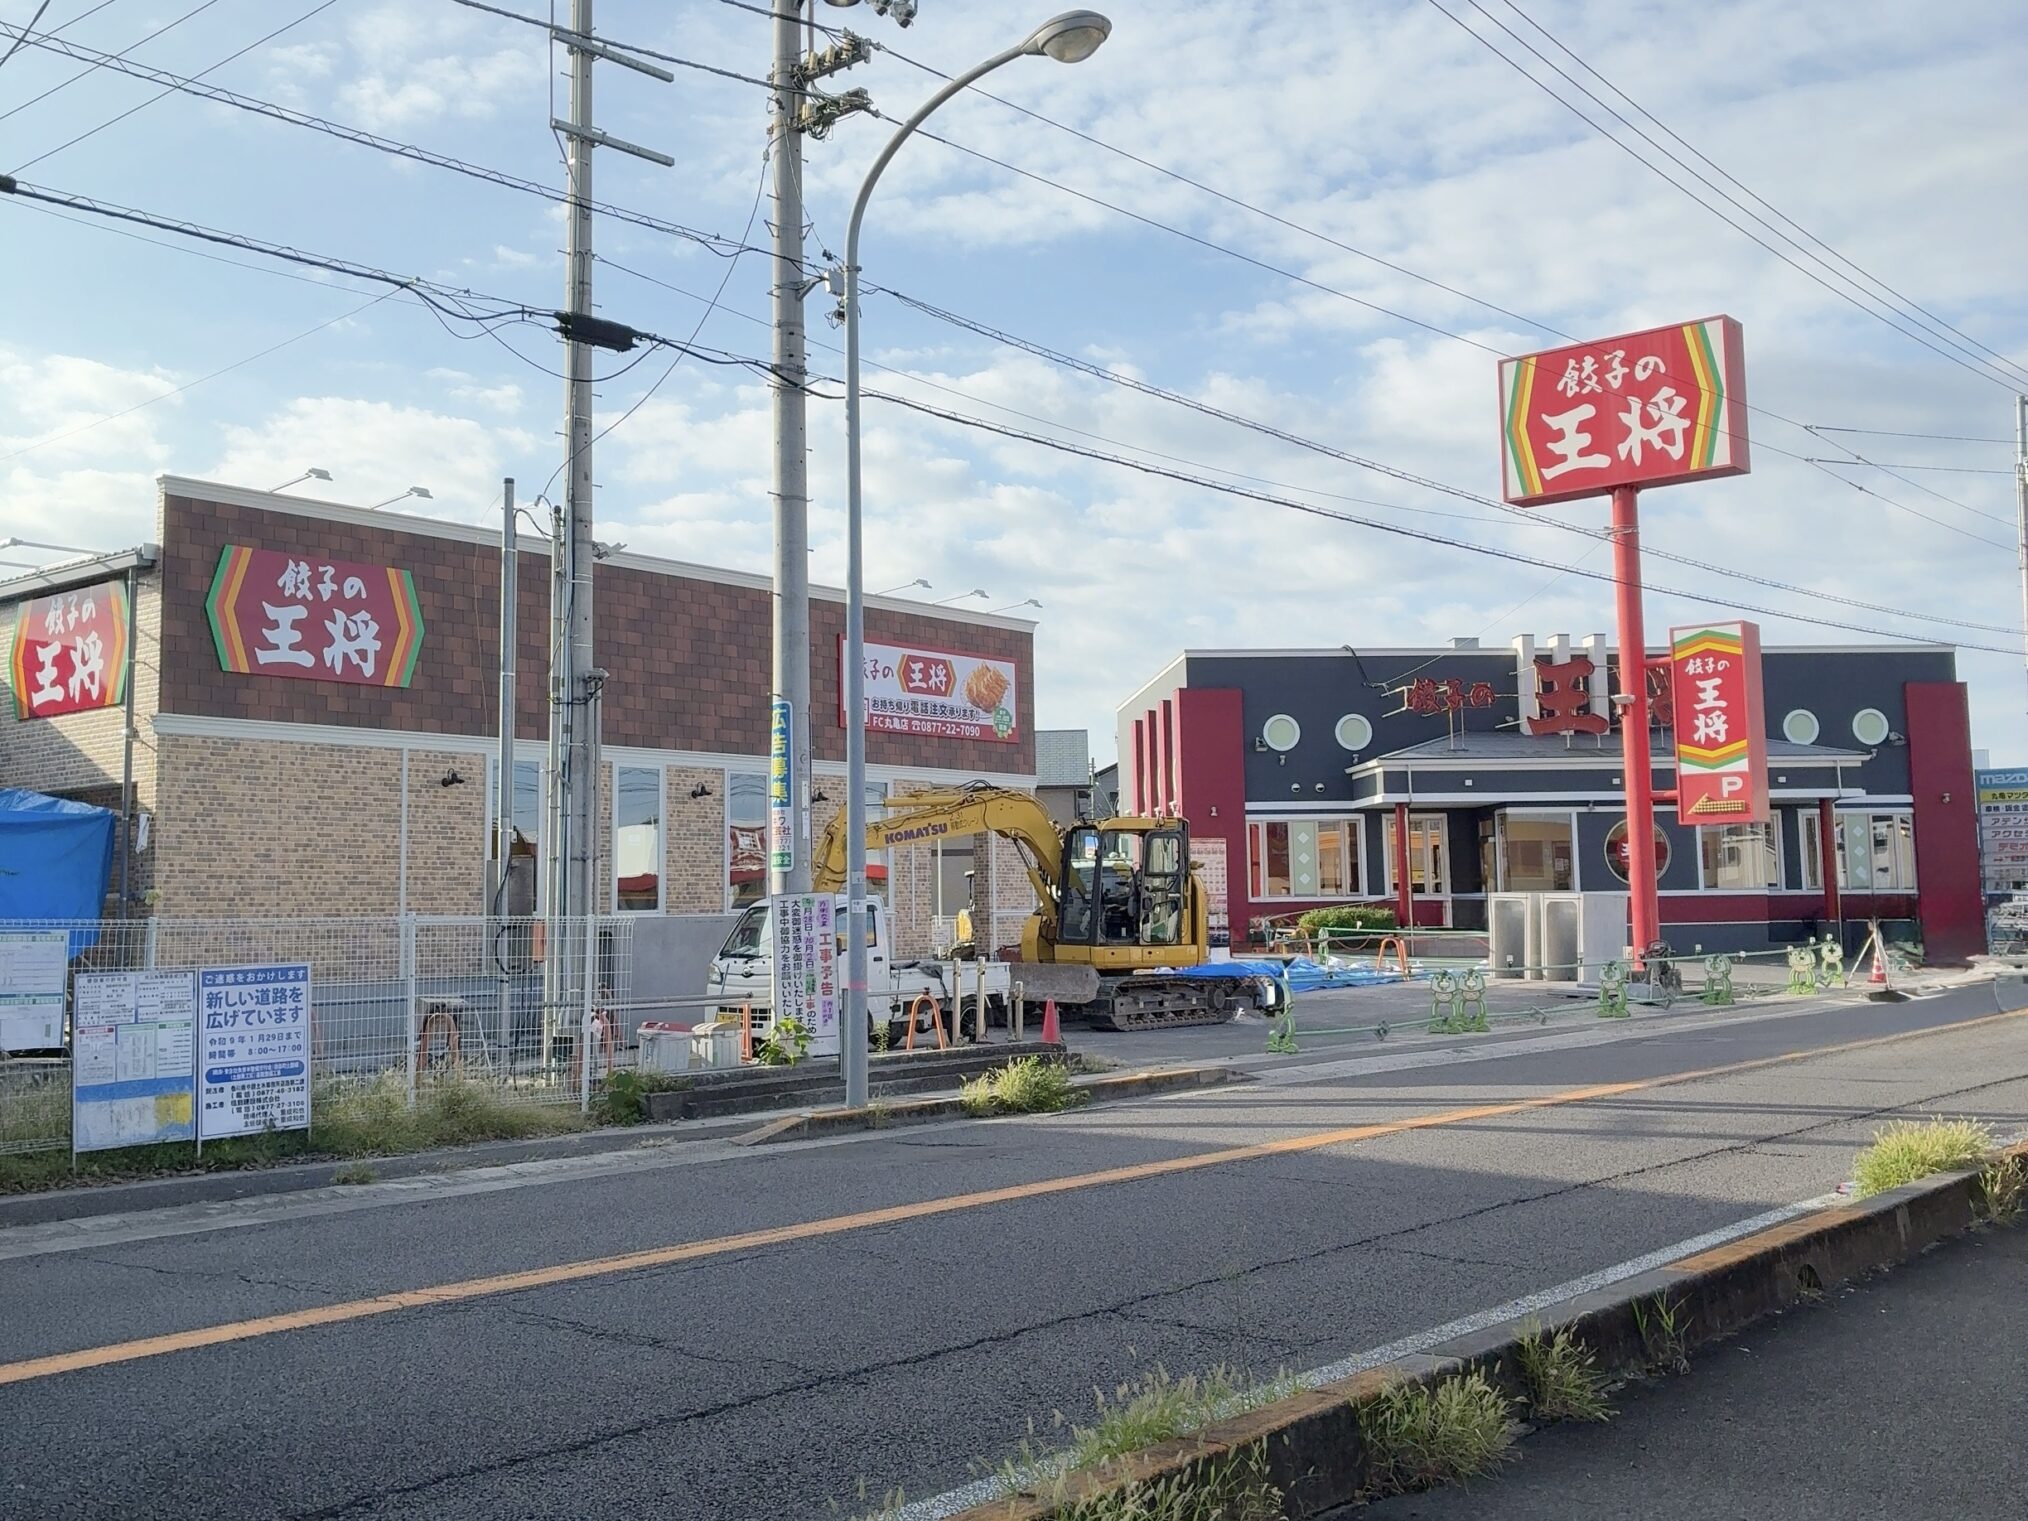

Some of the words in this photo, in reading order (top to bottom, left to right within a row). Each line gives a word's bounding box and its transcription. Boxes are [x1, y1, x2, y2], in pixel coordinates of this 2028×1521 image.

[1557, 350, 1666, 398] 餃子の
[1541, 386, 1691, 480] 王将
[277, 559, 367, 602] 餃子の
[45, 593, 96, 636] 餃子の
[255, 601, 382, 678] 王将
[31, 631, 104, 708] 王将
[863, 656, 894, 680] 子の
[908, 661, 948, 692] 王将
[1685, 658, 1730, 675] 餃子の
[1407, 678, 1496, 713] 餃子の
[1693, 677, 1729, 744] 王将
[772, 707, 788, 803] 広告募集
[1721, 776, 1743, 798] P
[884, 822, 948, 845] KOMATSU
[204, 969, 306, 985] ご迷惑をおかけします
[779, 900, 793, 1019] 工事中御協力をお願いいたし
[819, 933, 834, 996] 工事予告
[205, 986, 304, 1010] 新しい道路を
[205, 1005, 304, 1030] 広げています
